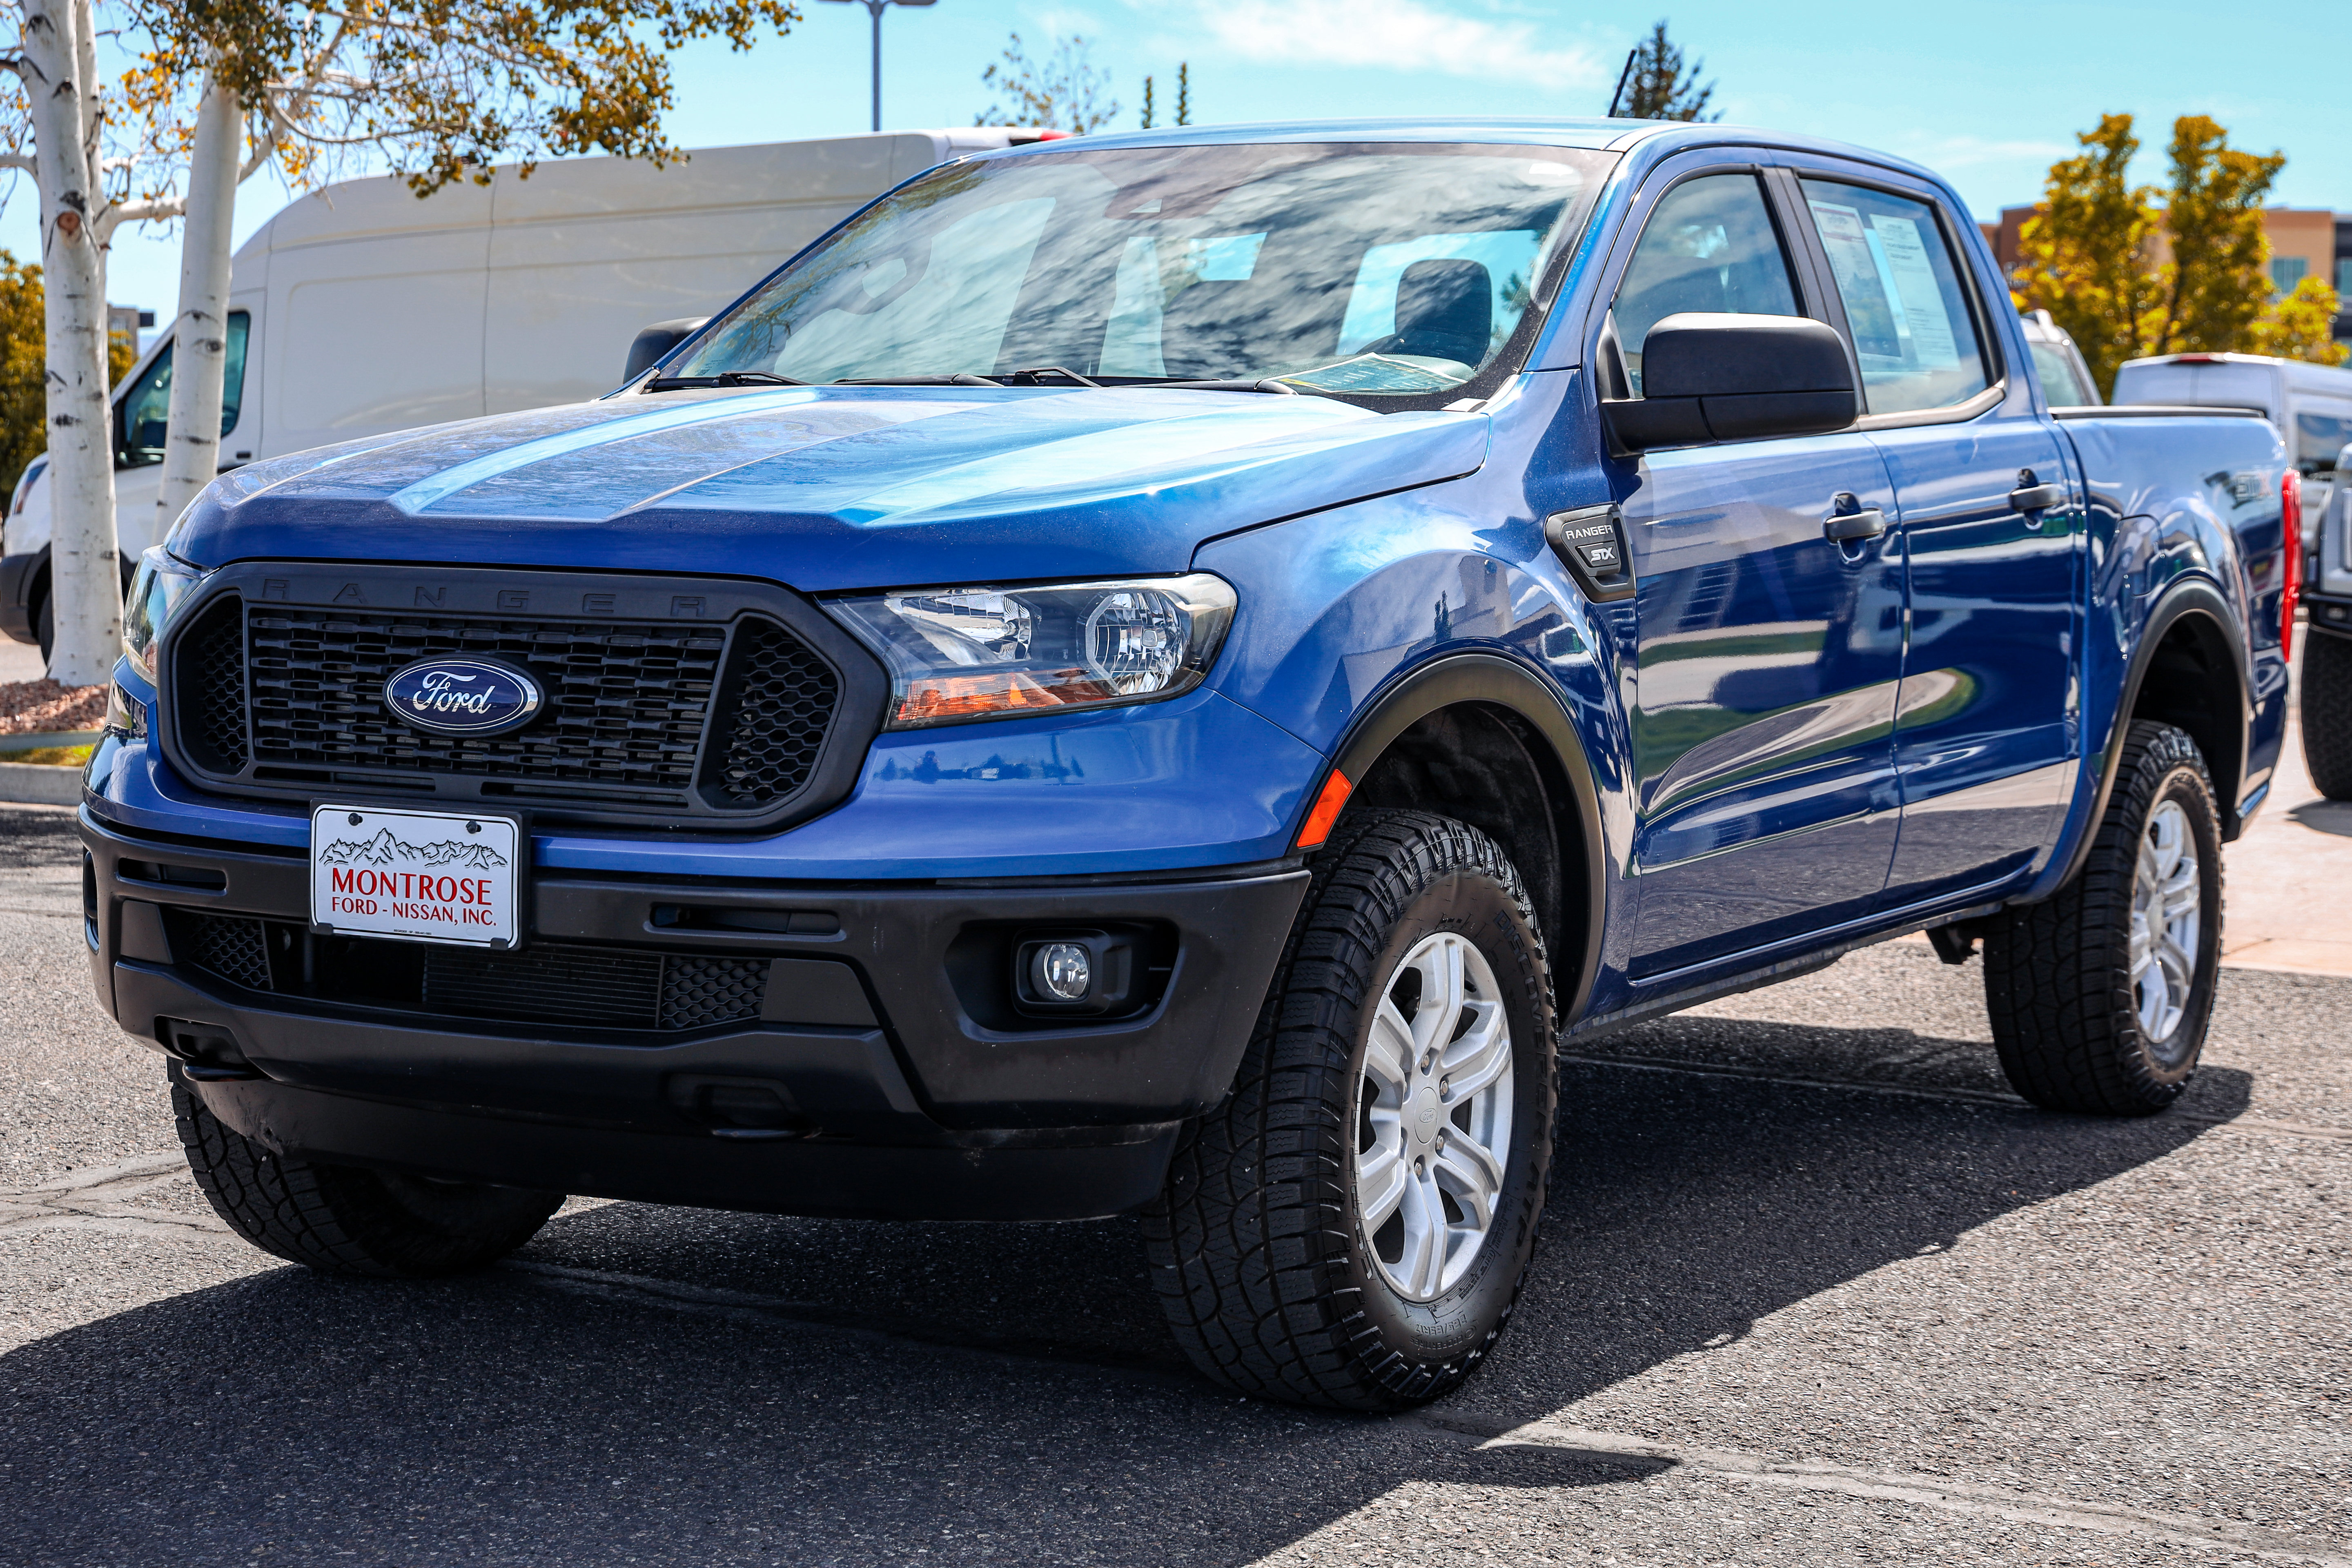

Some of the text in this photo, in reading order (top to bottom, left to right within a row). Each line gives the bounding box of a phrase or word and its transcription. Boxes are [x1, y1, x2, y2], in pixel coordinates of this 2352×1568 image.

[1566, 525, 1613, 540] RANGER
[1590, 546, 1616, 563] STX
[262, 579, 706, 617] RANGER
[413, 671, 495, 714] Ford
[332, 868, 492, 906] MONTROSE
[332, 897, 378, 915] FORD
[392, 902, 459, 926] NISSAN,
[463, 908, 497, 926] INC.
[1494, 910, 1548, 1140] DISCOVERER
[1415, 1314, 1467, 1335] 265/65R17
